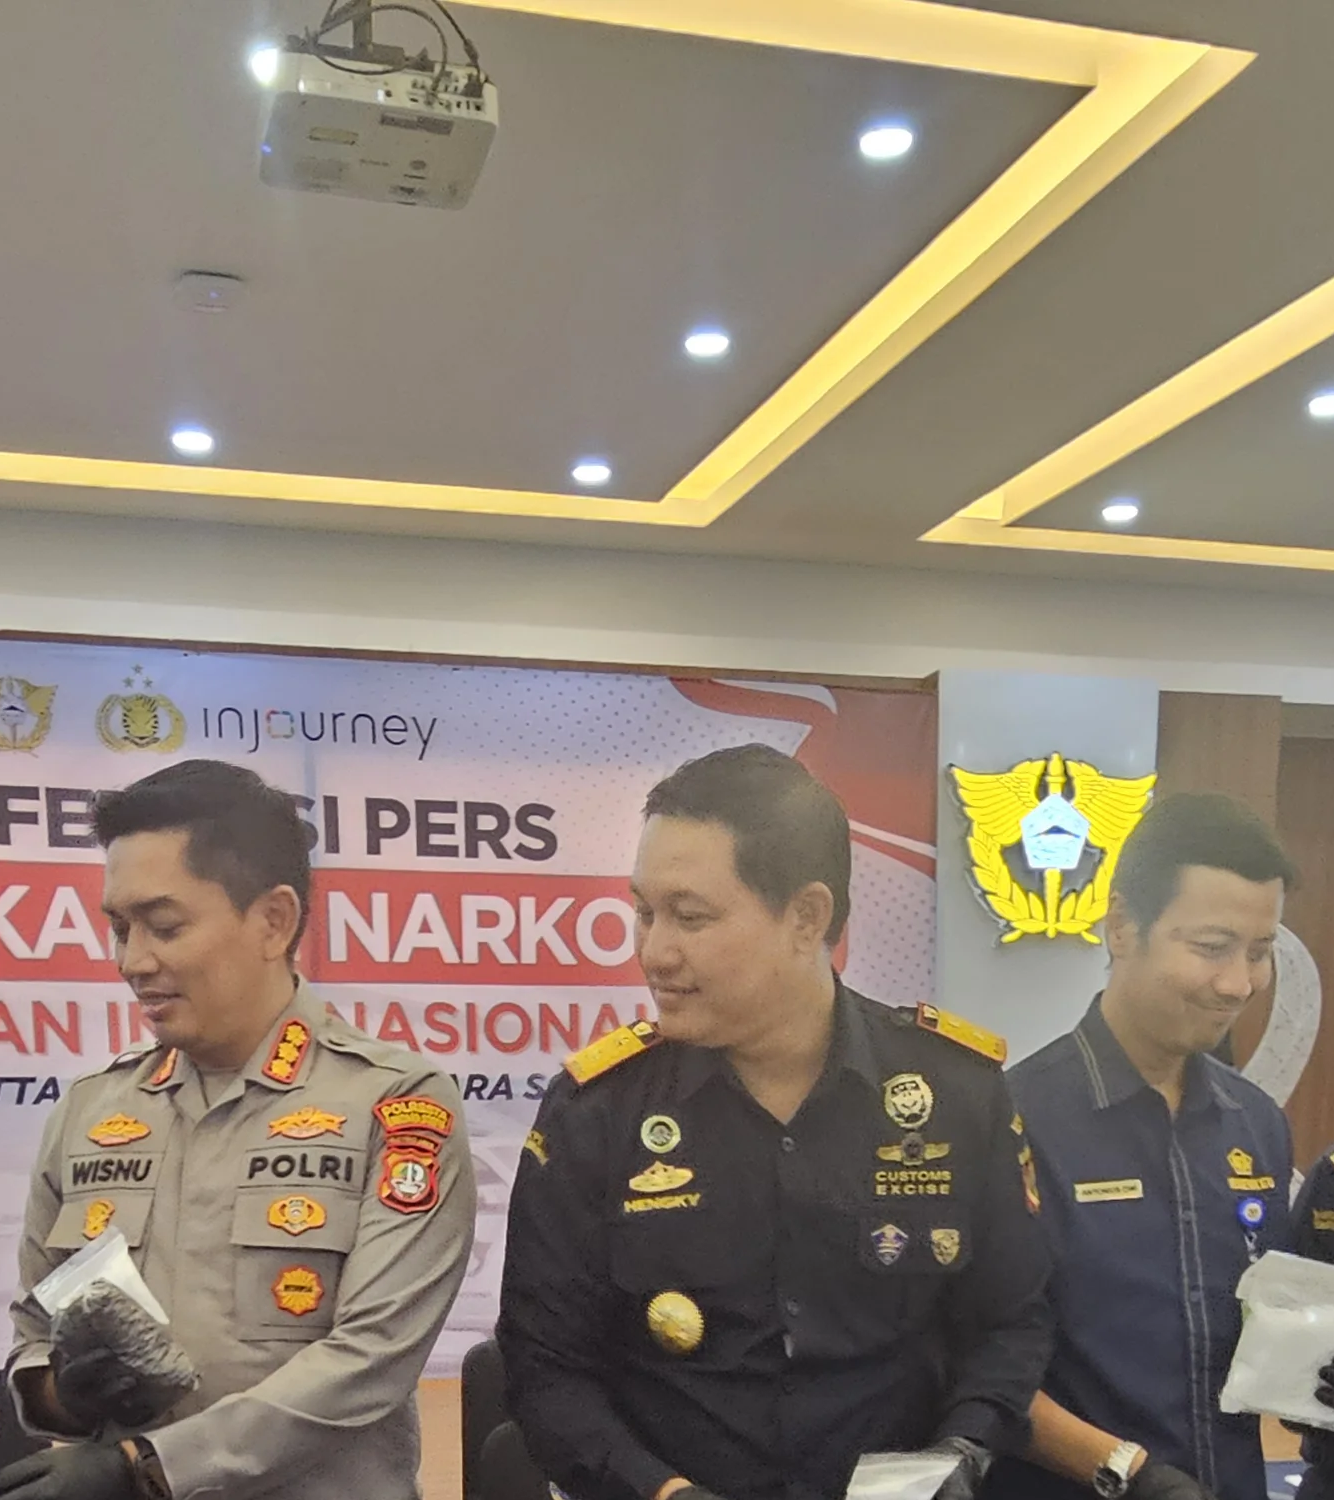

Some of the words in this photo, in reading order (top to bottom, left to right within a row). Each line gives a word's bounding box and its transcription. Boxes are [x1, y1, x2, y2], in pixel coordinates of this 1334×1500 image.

[203, 706, 437, 761] injourney
[365, 796, 558, 862] PERS
[329, 884, 636, 967] NARKO
[71, 1158, 153, 1186] WISNU
[247, 1153, 354, 1184] POLRI
[874, 1170, 952, 1182] CUSTOMS
[874, 1183, 951, 1196] EXCISE
